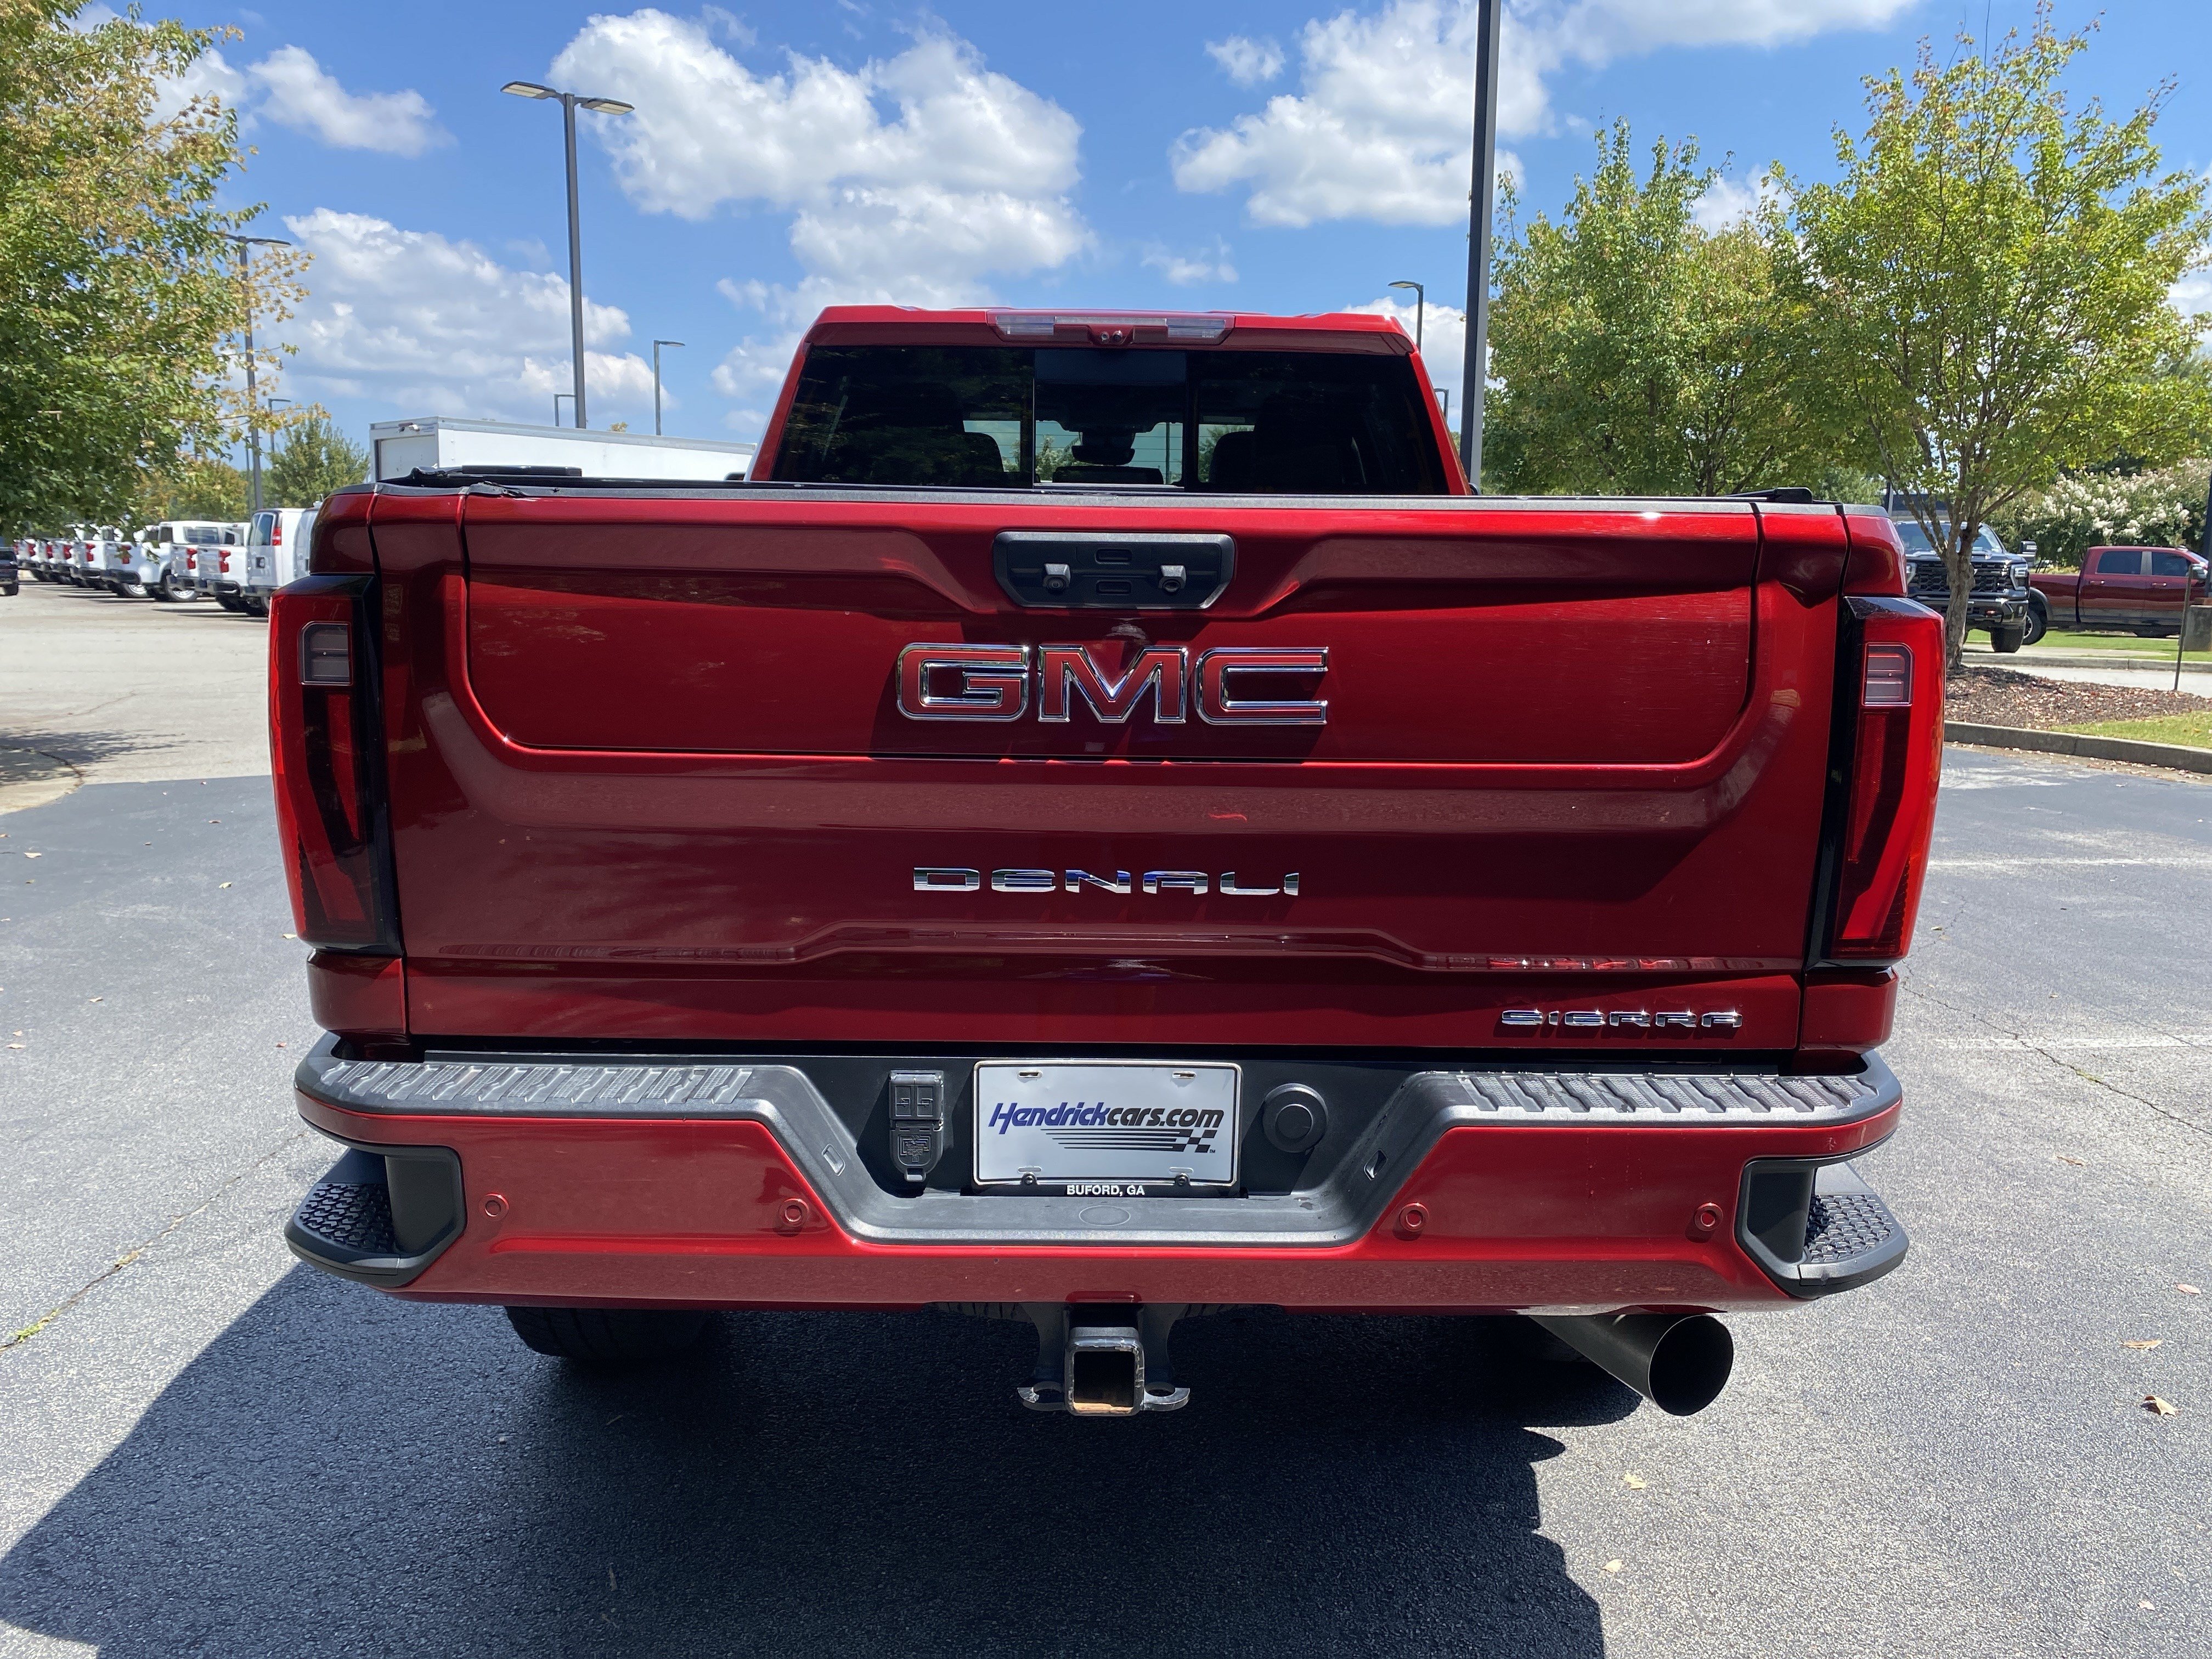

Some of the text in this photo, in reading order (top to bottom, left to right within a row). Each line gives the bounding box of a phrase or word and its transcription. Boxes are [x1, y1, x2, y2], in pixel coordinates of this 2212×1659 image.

[896, 642, 1329, 725] GMC
[913, 867, 1299, 896] DENALI
[1501, 1008, 1743, 1028] SIERRA
[988, 1102, 1224, 1135] Hendrickcars.com
[1066, 1184, 1146, 1197] BUFORD, GA
